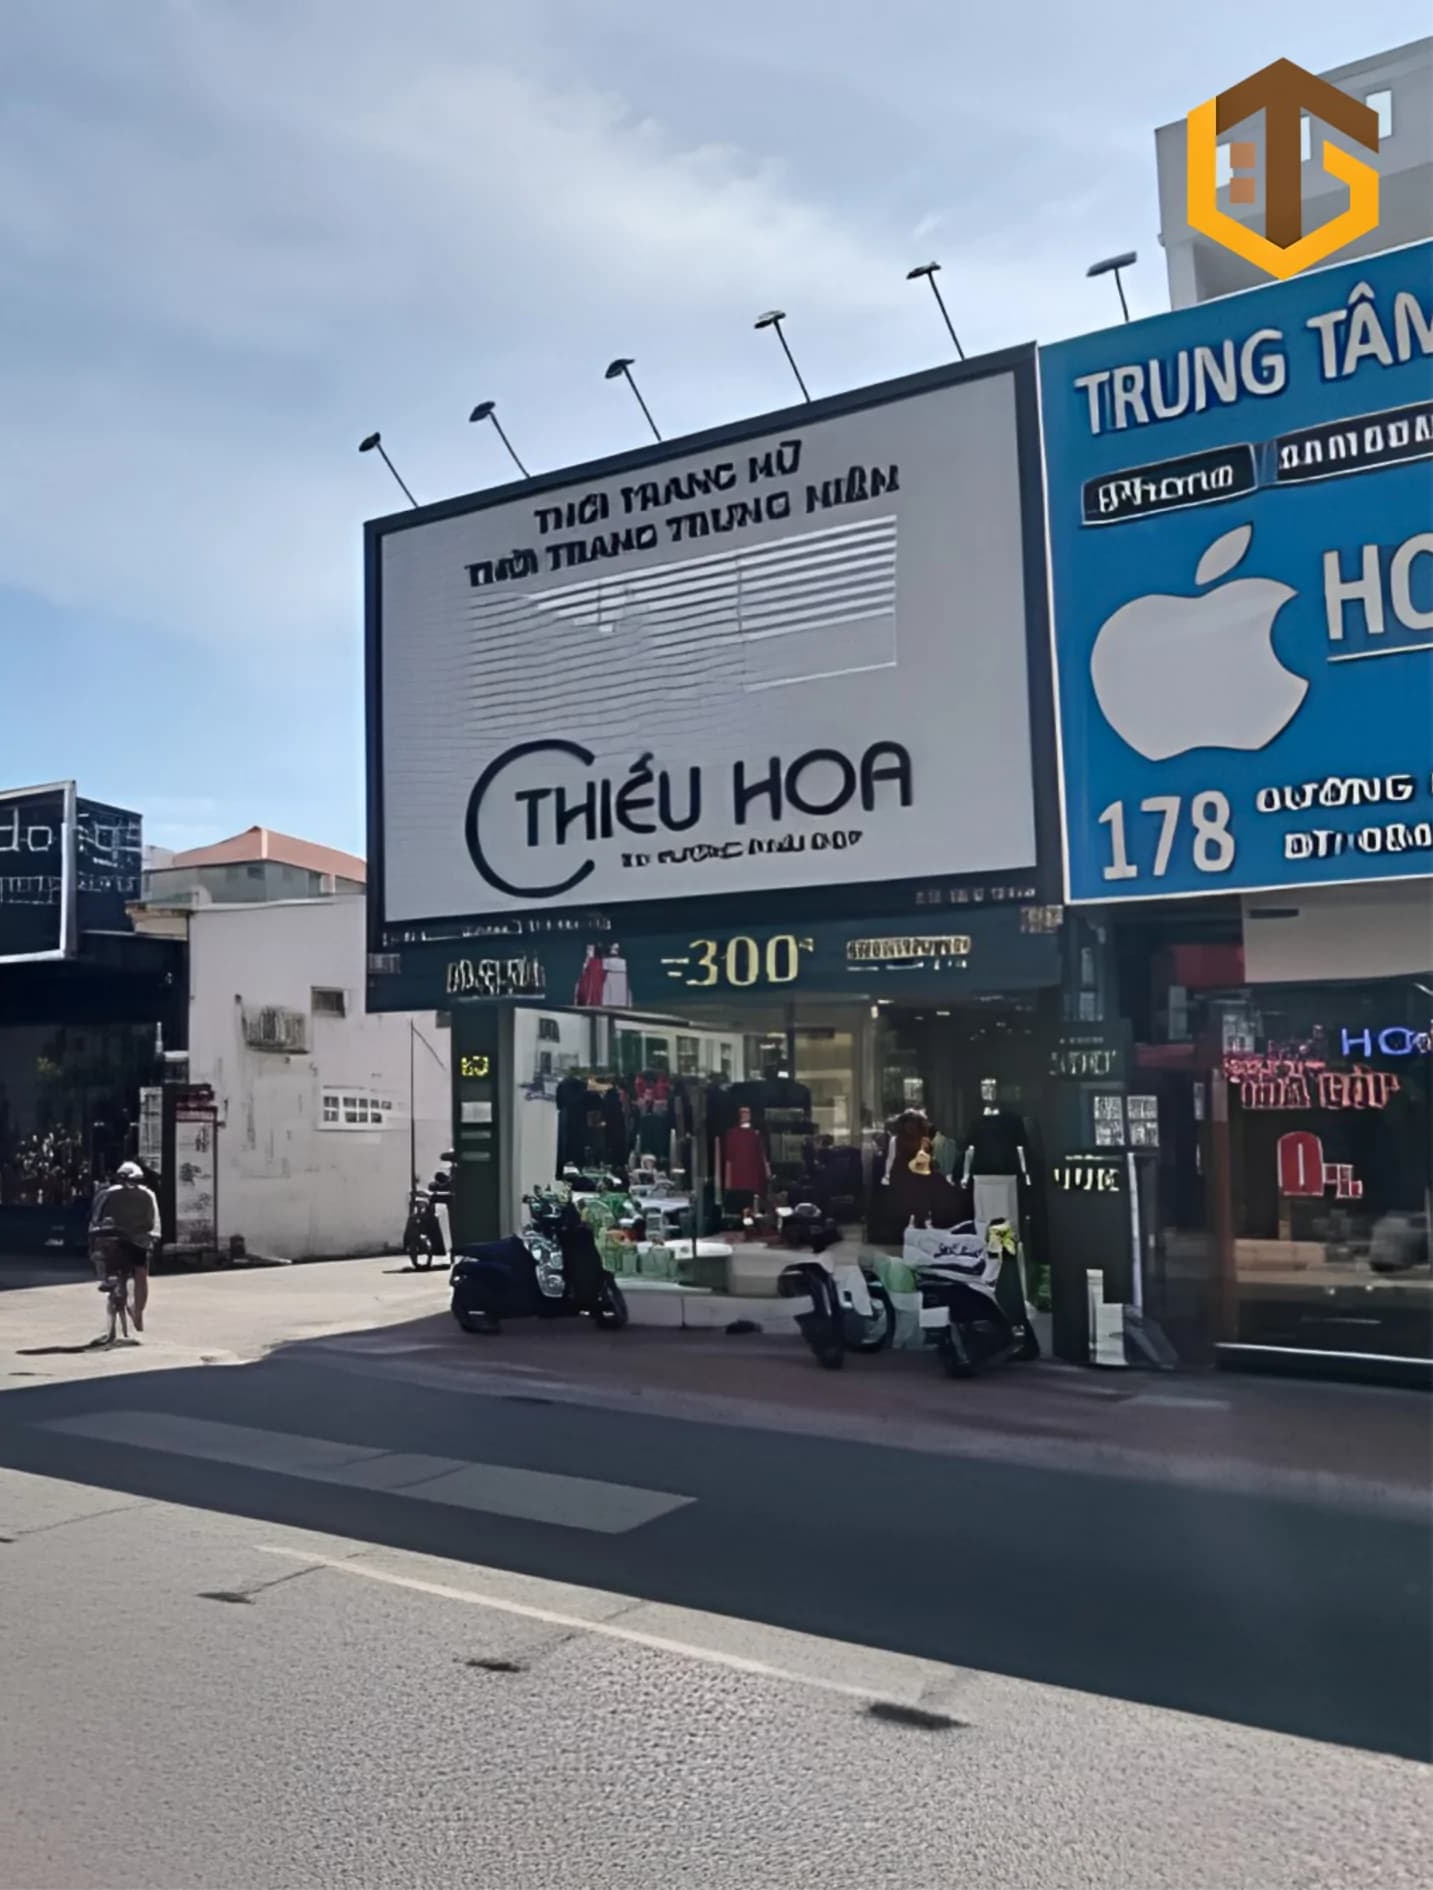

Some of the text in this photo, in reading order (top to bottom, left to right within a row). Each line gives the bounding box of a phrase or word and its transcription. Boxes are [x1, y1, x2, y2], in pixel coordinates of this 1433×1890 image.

[1074, 329, 1286, 434] TRUNG
[733, 741, 913, 825] HOA
[1098, 790, 1235, 880] 178
